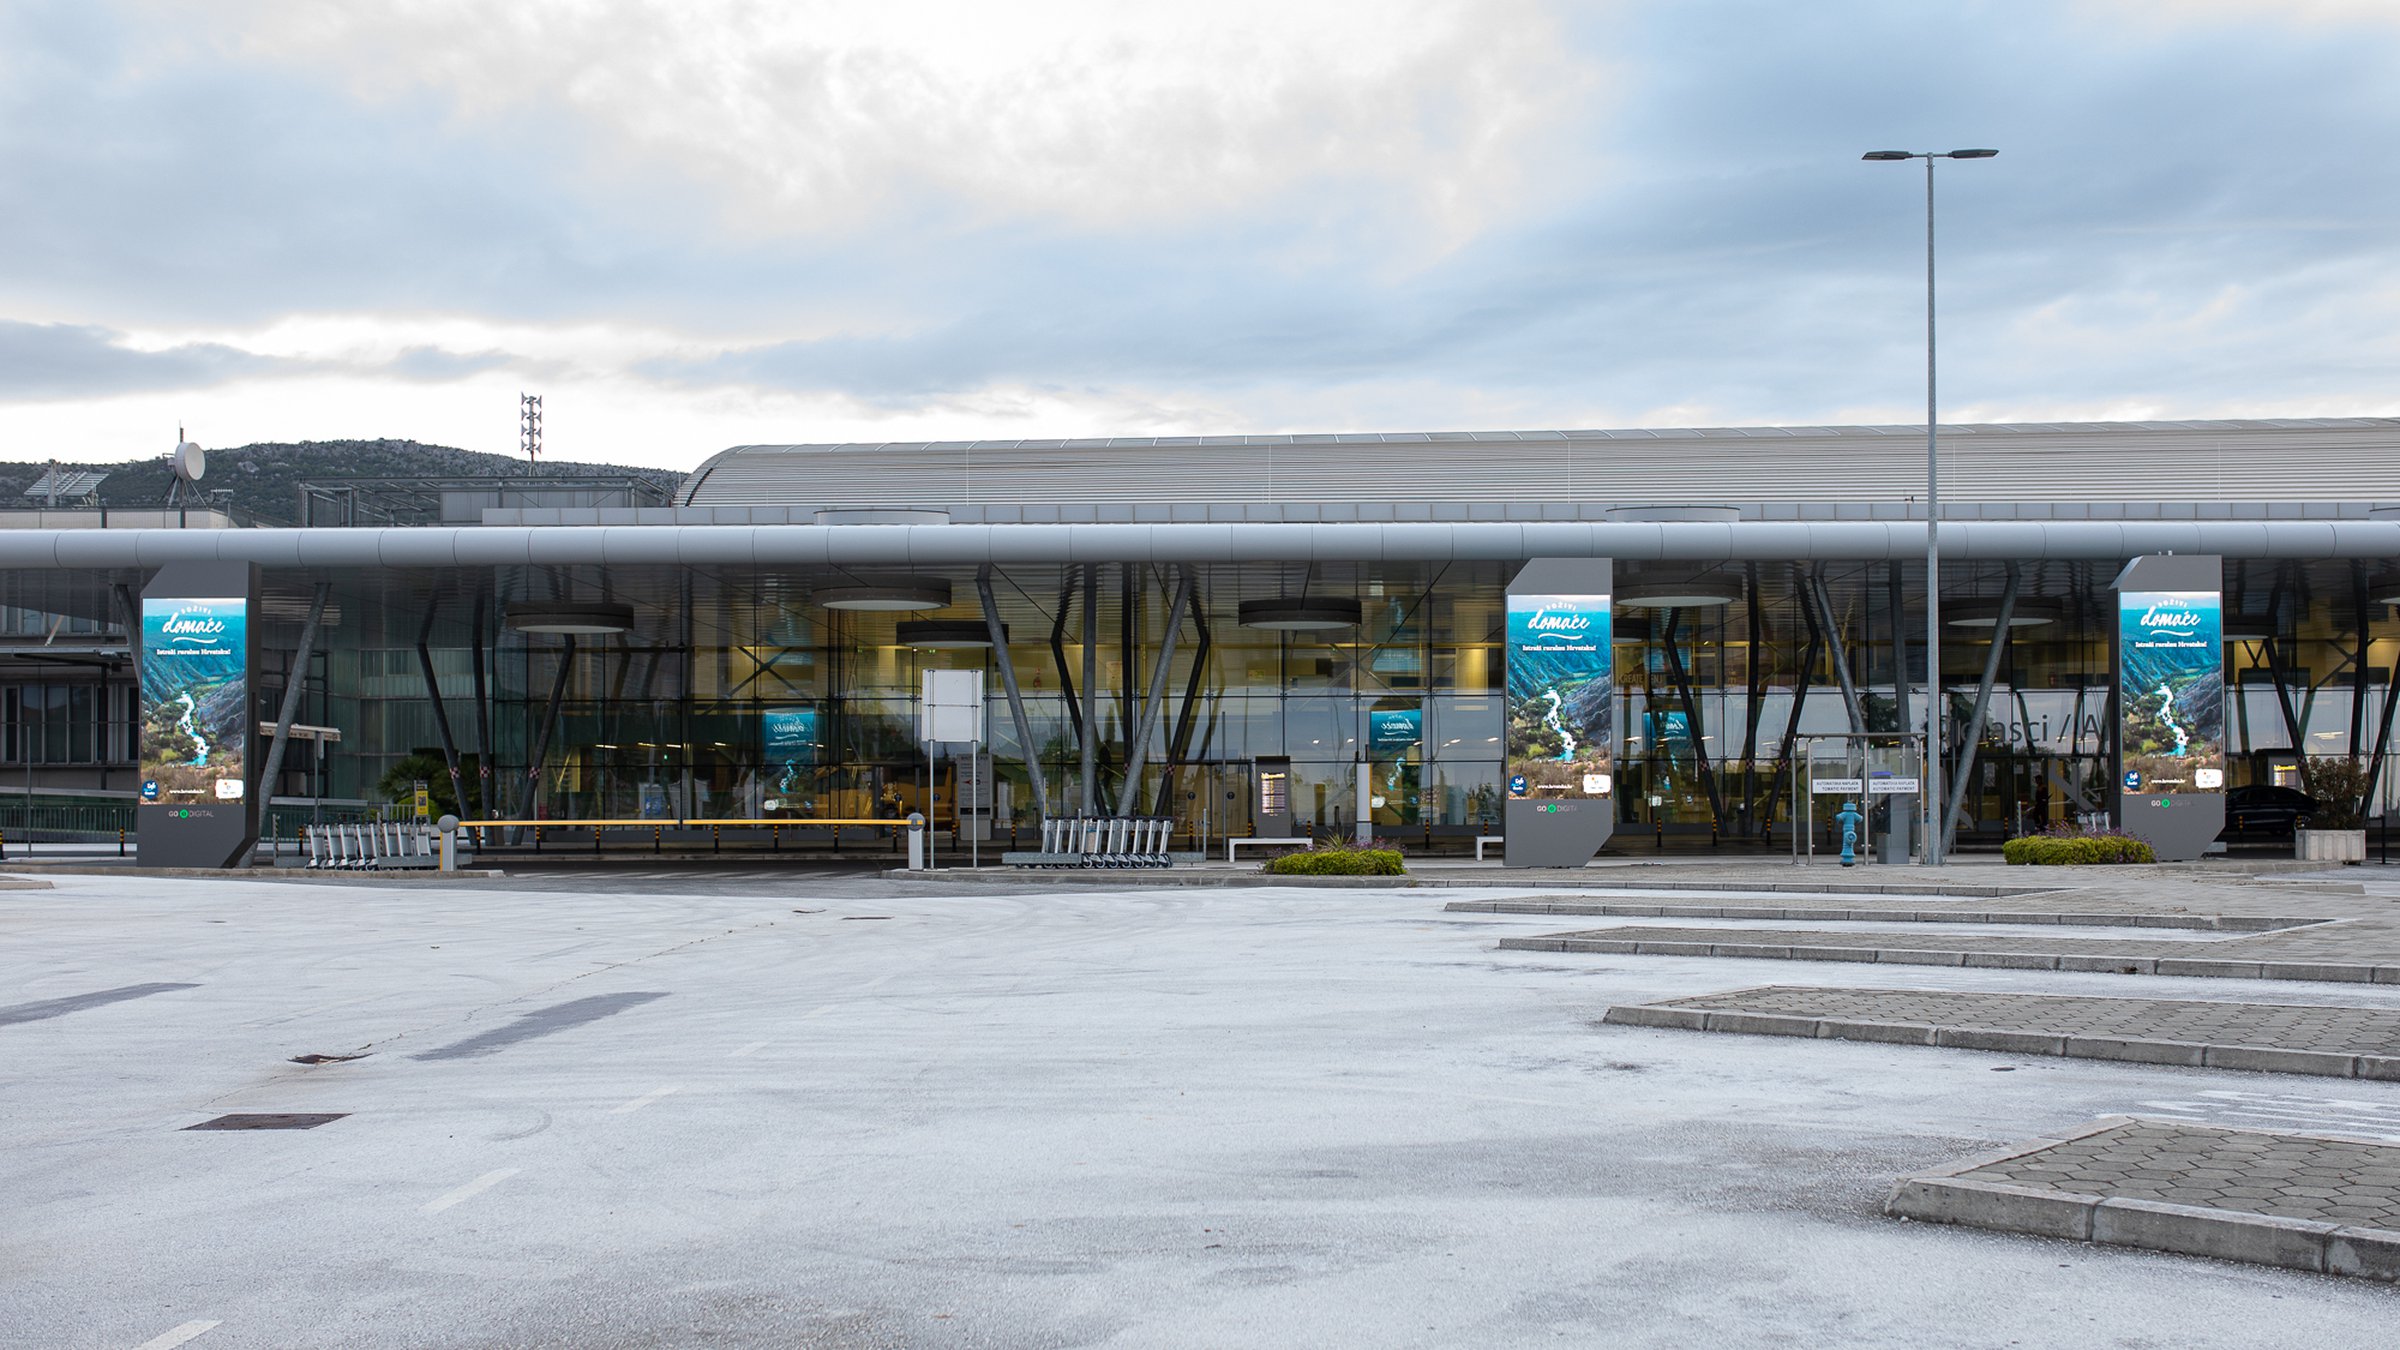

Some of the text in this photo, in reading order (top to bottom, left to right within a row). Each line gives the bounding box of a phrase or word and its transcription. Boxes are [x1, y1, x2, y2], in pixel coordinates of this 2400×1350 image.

[162, 612, 226, 634] domaće
[1527, 608, 1590, 630] domaće
[2140, 606, 2202, 626] domaće
